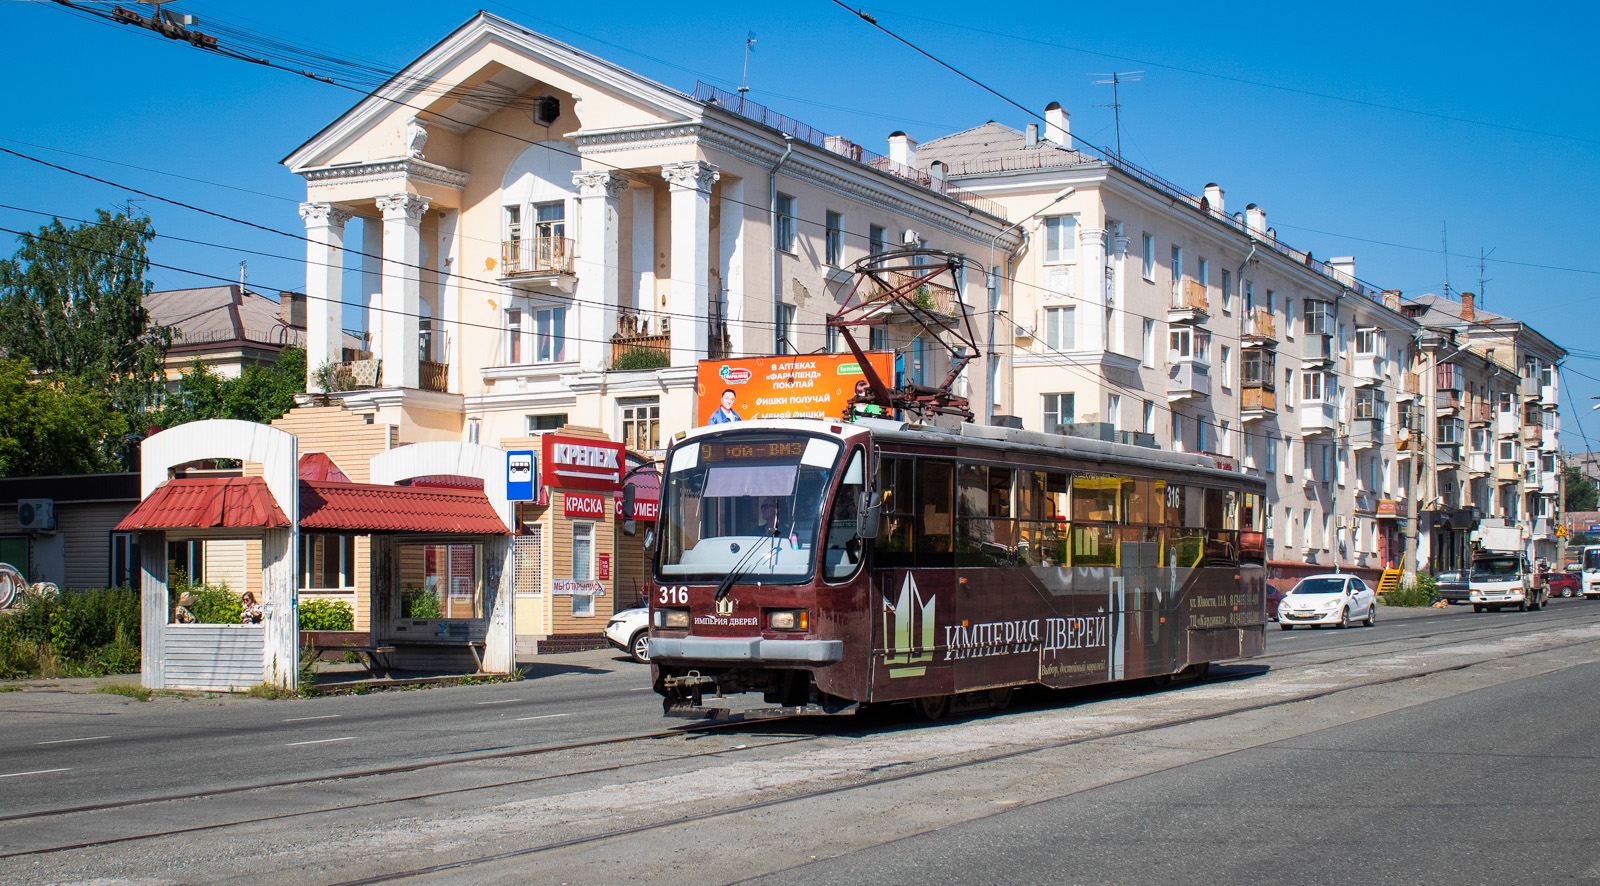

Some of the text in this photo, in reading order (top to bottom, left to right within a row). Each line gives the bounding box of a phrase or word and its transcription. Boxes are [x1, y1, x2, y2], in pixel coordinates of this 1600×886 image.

[778, 362, 816, 371] АПТЕКАХ
[773, 379, 814, 390] ПОКУПАЙ
[789, 393, 831, 404] ПОЛУЧАЙ
[554, 443, 619, 469] КРЕПЕЖ
[701, 444, 712, 459] 9
[1166, 485, 1180, 508] 316
[566, 496, 603, 513] КРАСКА
[553, 582, 565, 591] МЫ
[659, 586, 688, 604] 316
[694, 616, 758, 626] ИМПЕРИЯ ДВЕРЕЙ
[943, 613, 1106, 661] ИМПЕРИЯ ДВЕРЕЙ
